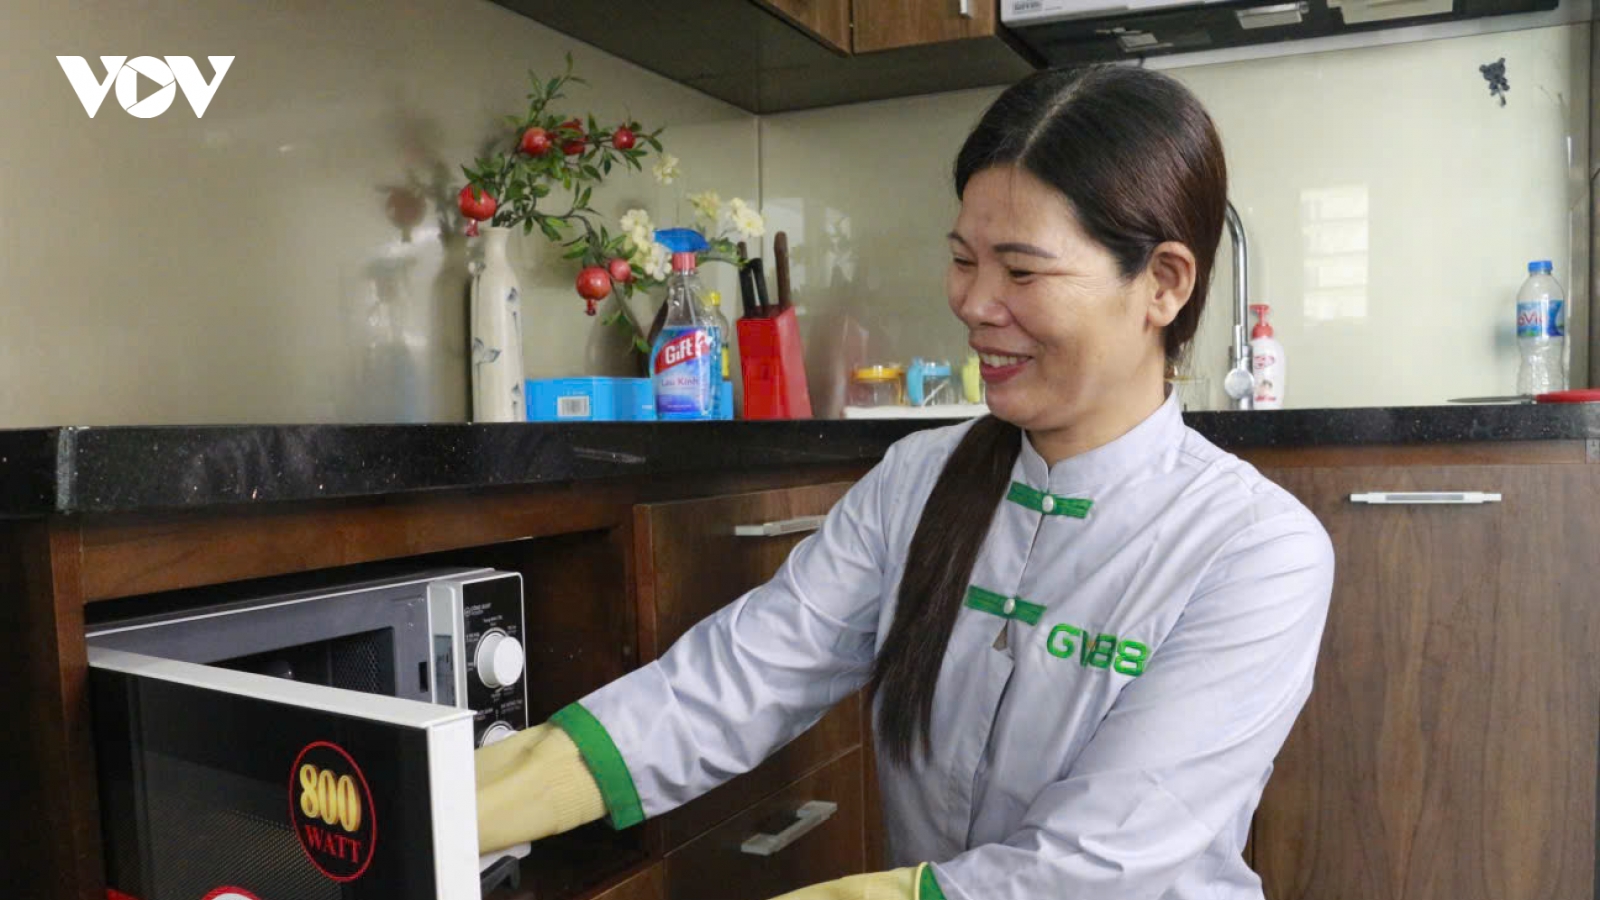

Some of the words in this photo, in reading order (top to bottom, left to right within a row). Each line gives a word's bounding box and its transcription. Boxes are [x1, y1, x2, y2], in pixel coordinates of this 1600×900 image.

[665, 337, 693, 365] Gift
[299, 763, 362, 832] 800
[304, 824, 362, 863] WATT
